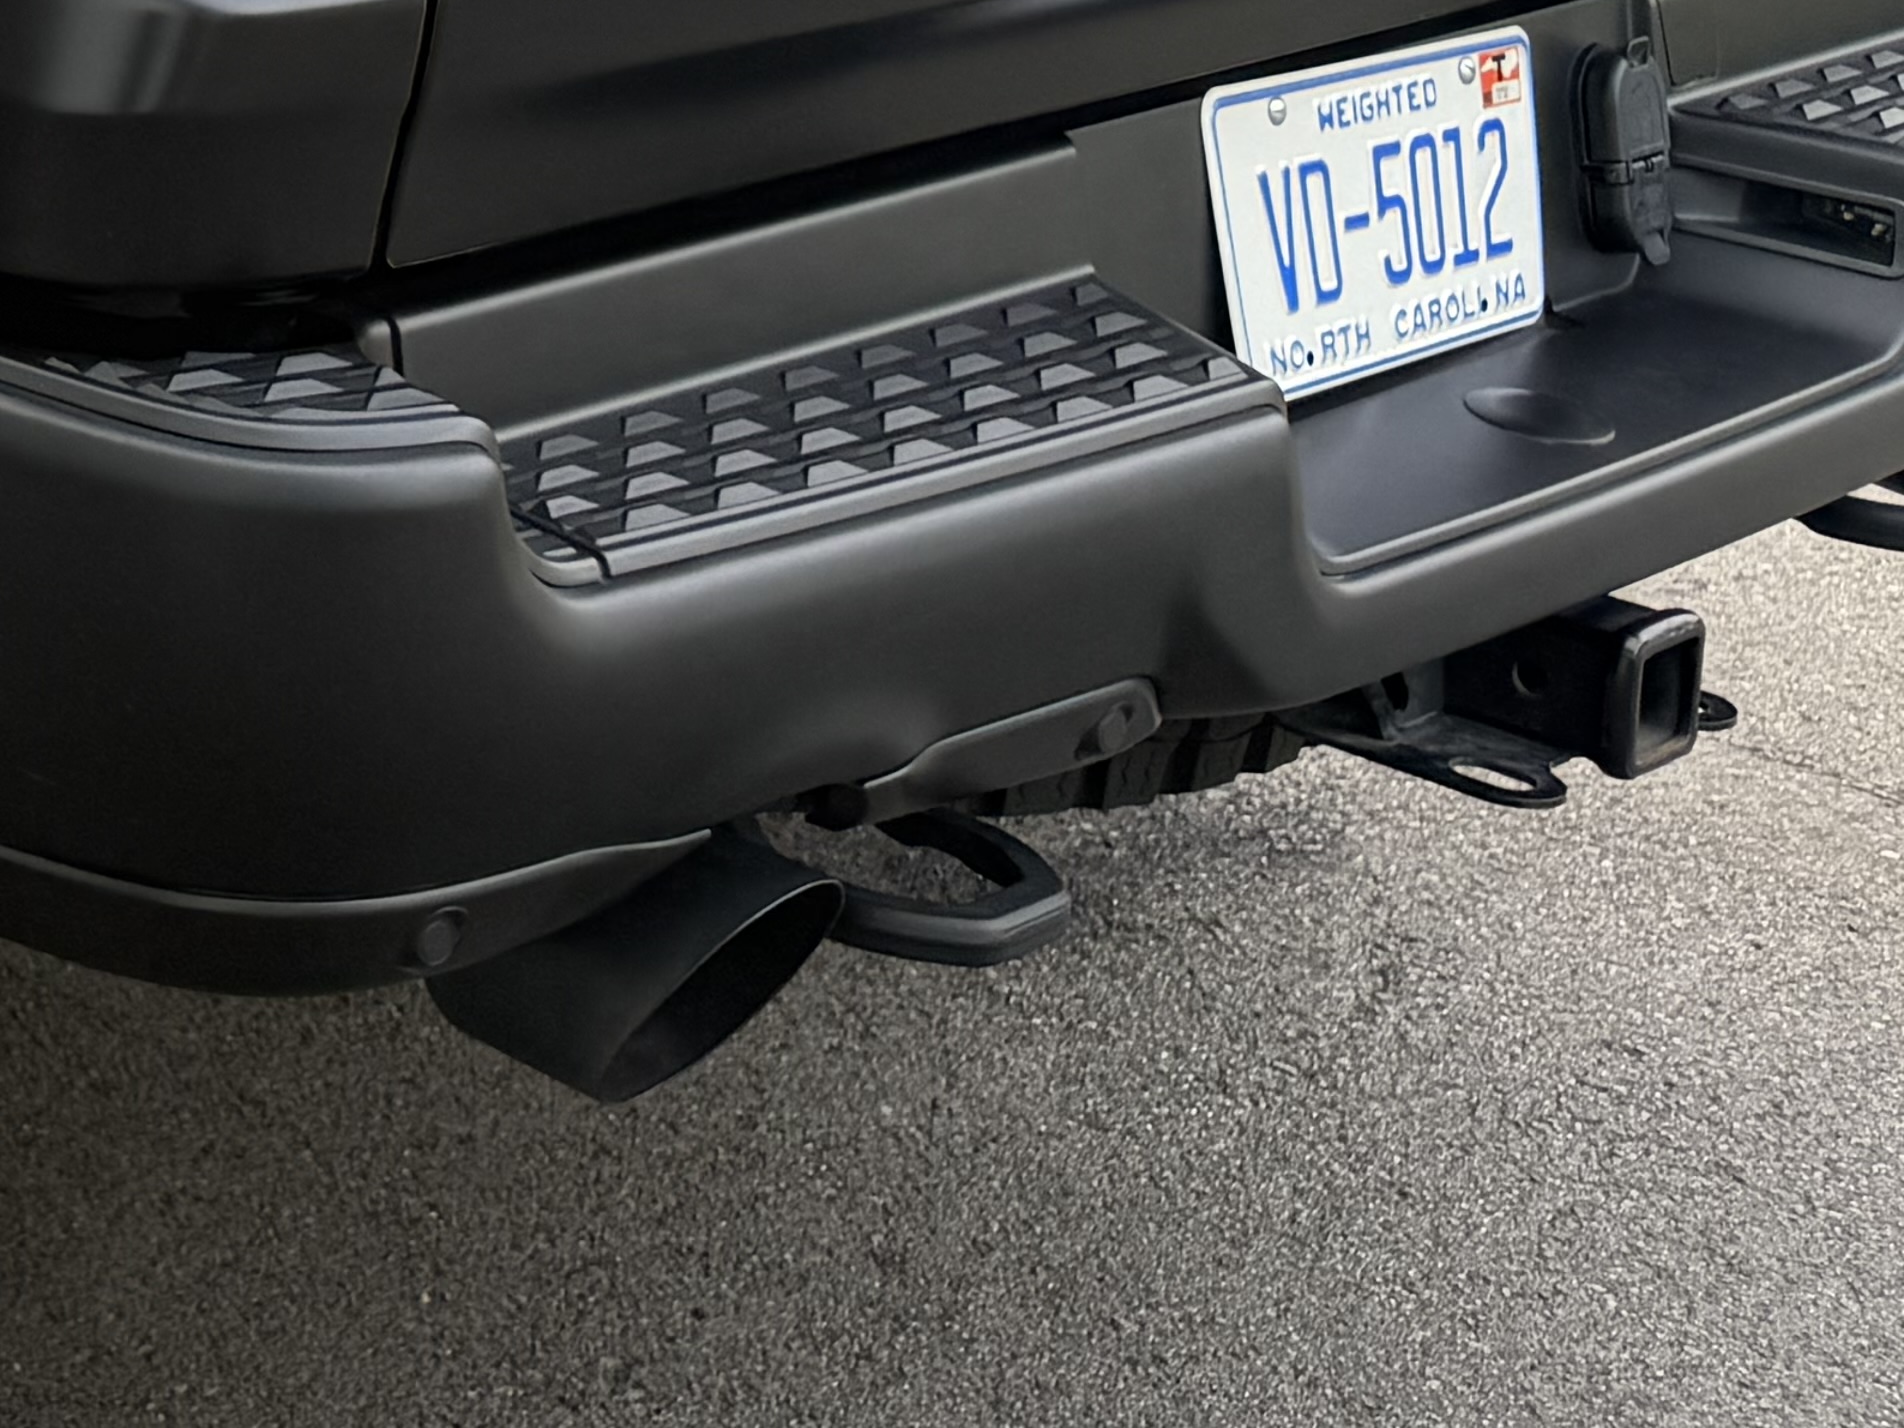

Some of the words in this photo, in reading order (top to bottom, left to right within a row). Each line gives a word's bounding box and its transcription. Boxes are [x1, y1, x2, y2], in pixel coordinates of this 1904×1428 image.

[1317, 77, 1438, 132] WEIGHTED
[1269, 321, 1372, 376] NORTH
[1394, 272, 1527, 338] CAROLINA
